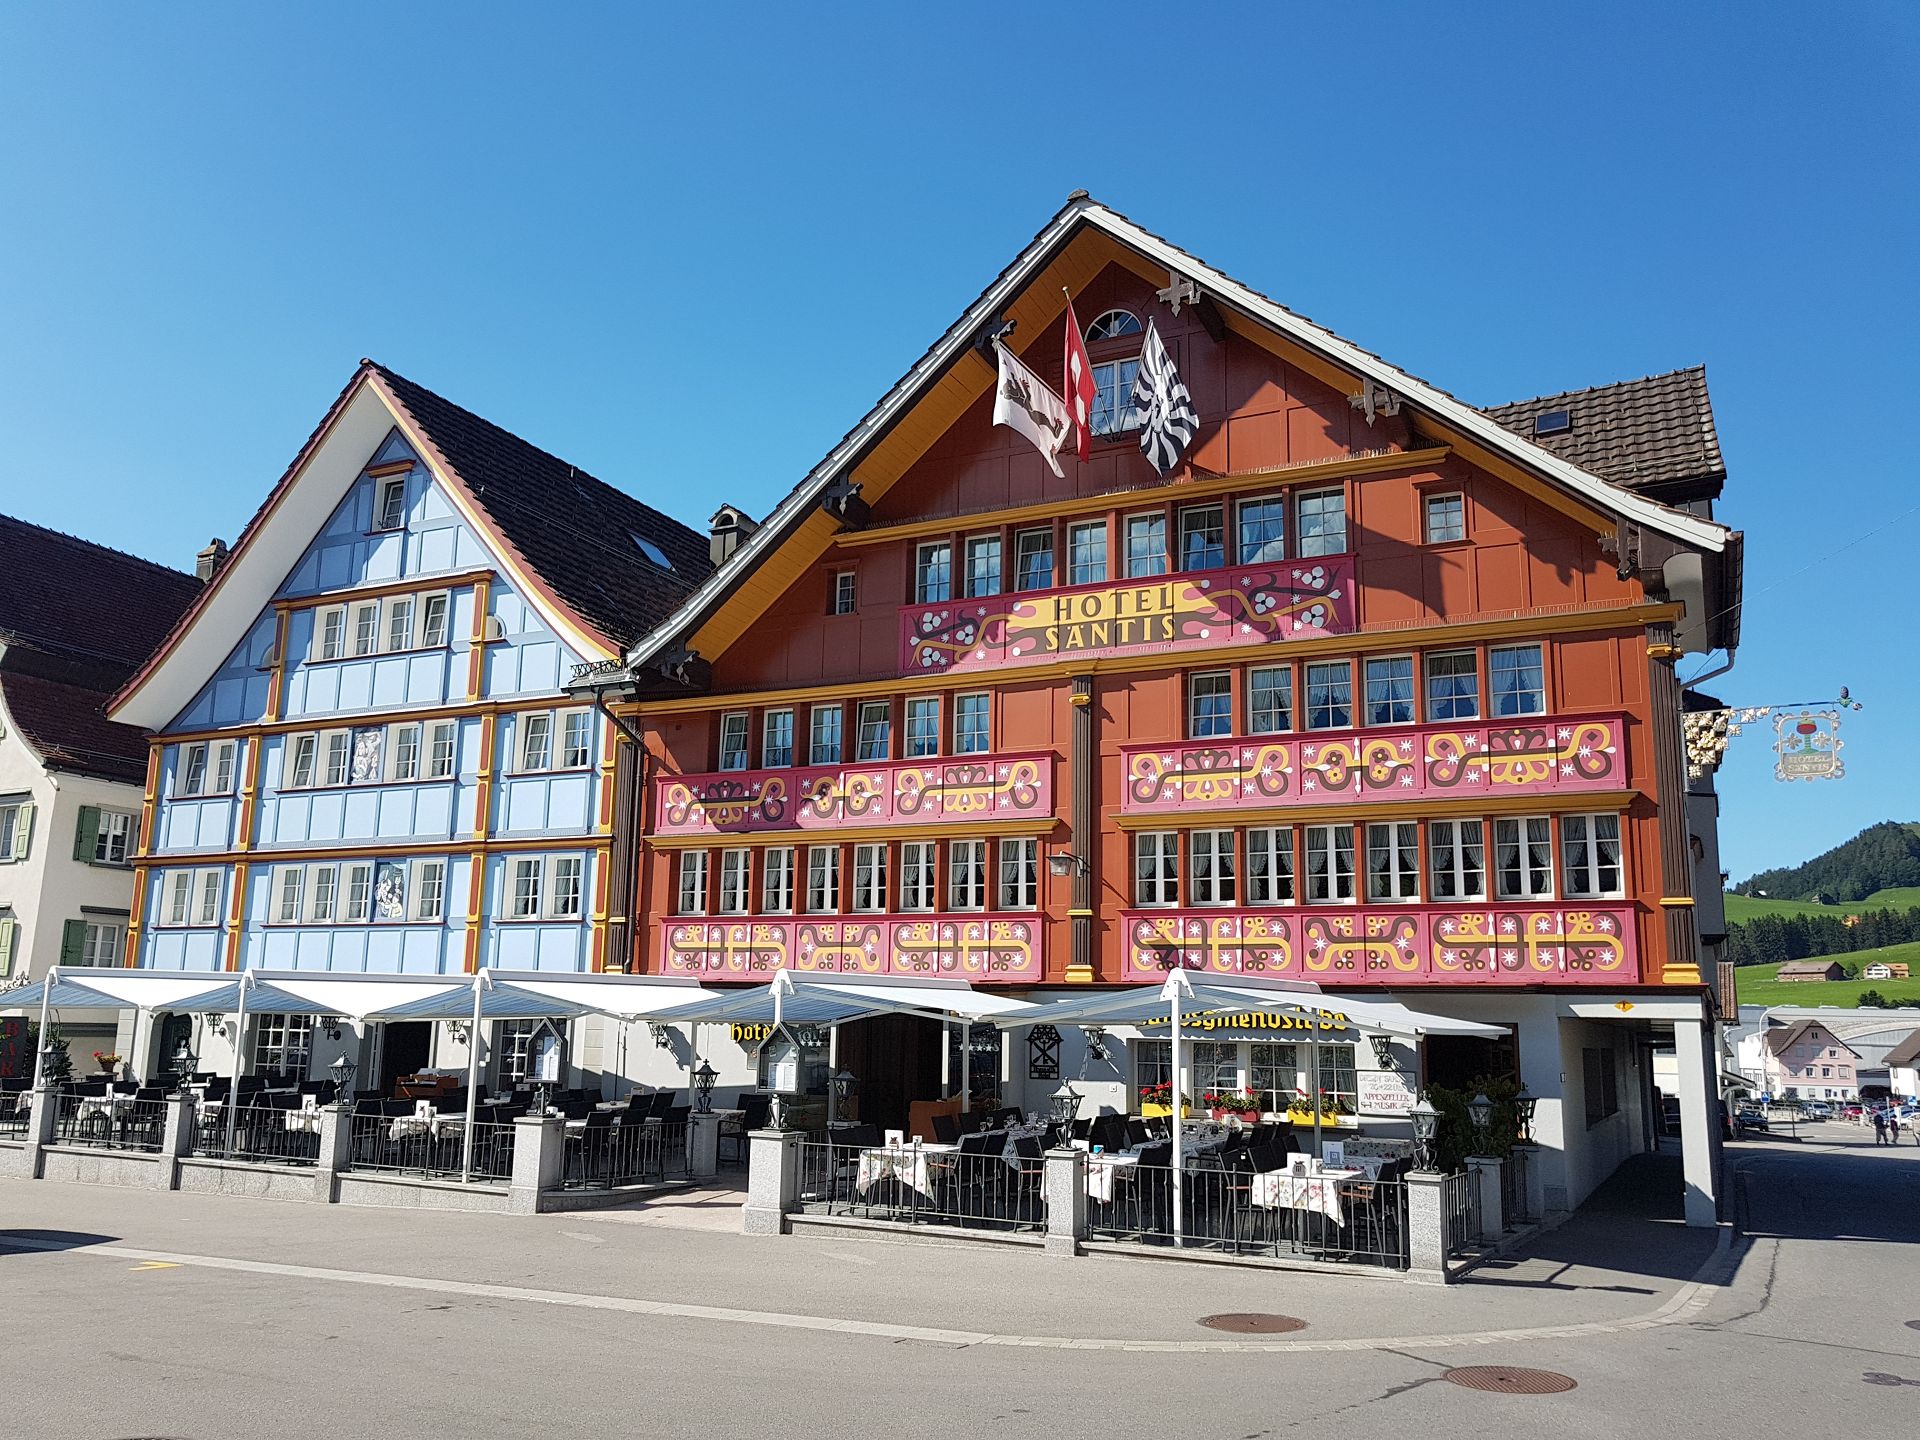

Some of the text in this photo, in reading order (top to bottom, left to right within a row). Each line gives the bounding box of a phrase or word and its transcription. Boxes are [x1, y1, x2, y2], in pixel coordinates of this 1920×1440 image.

[1053, 587, 1174, 621] HOTEL
[1045, 615, 1175, 651] SÄNTIS
[731, 1022, 775, 1042] hote
[1364, 1092, 1410, 1102] APPENZELLER
[1375, 1101, 1398, 1110] MUSIK
